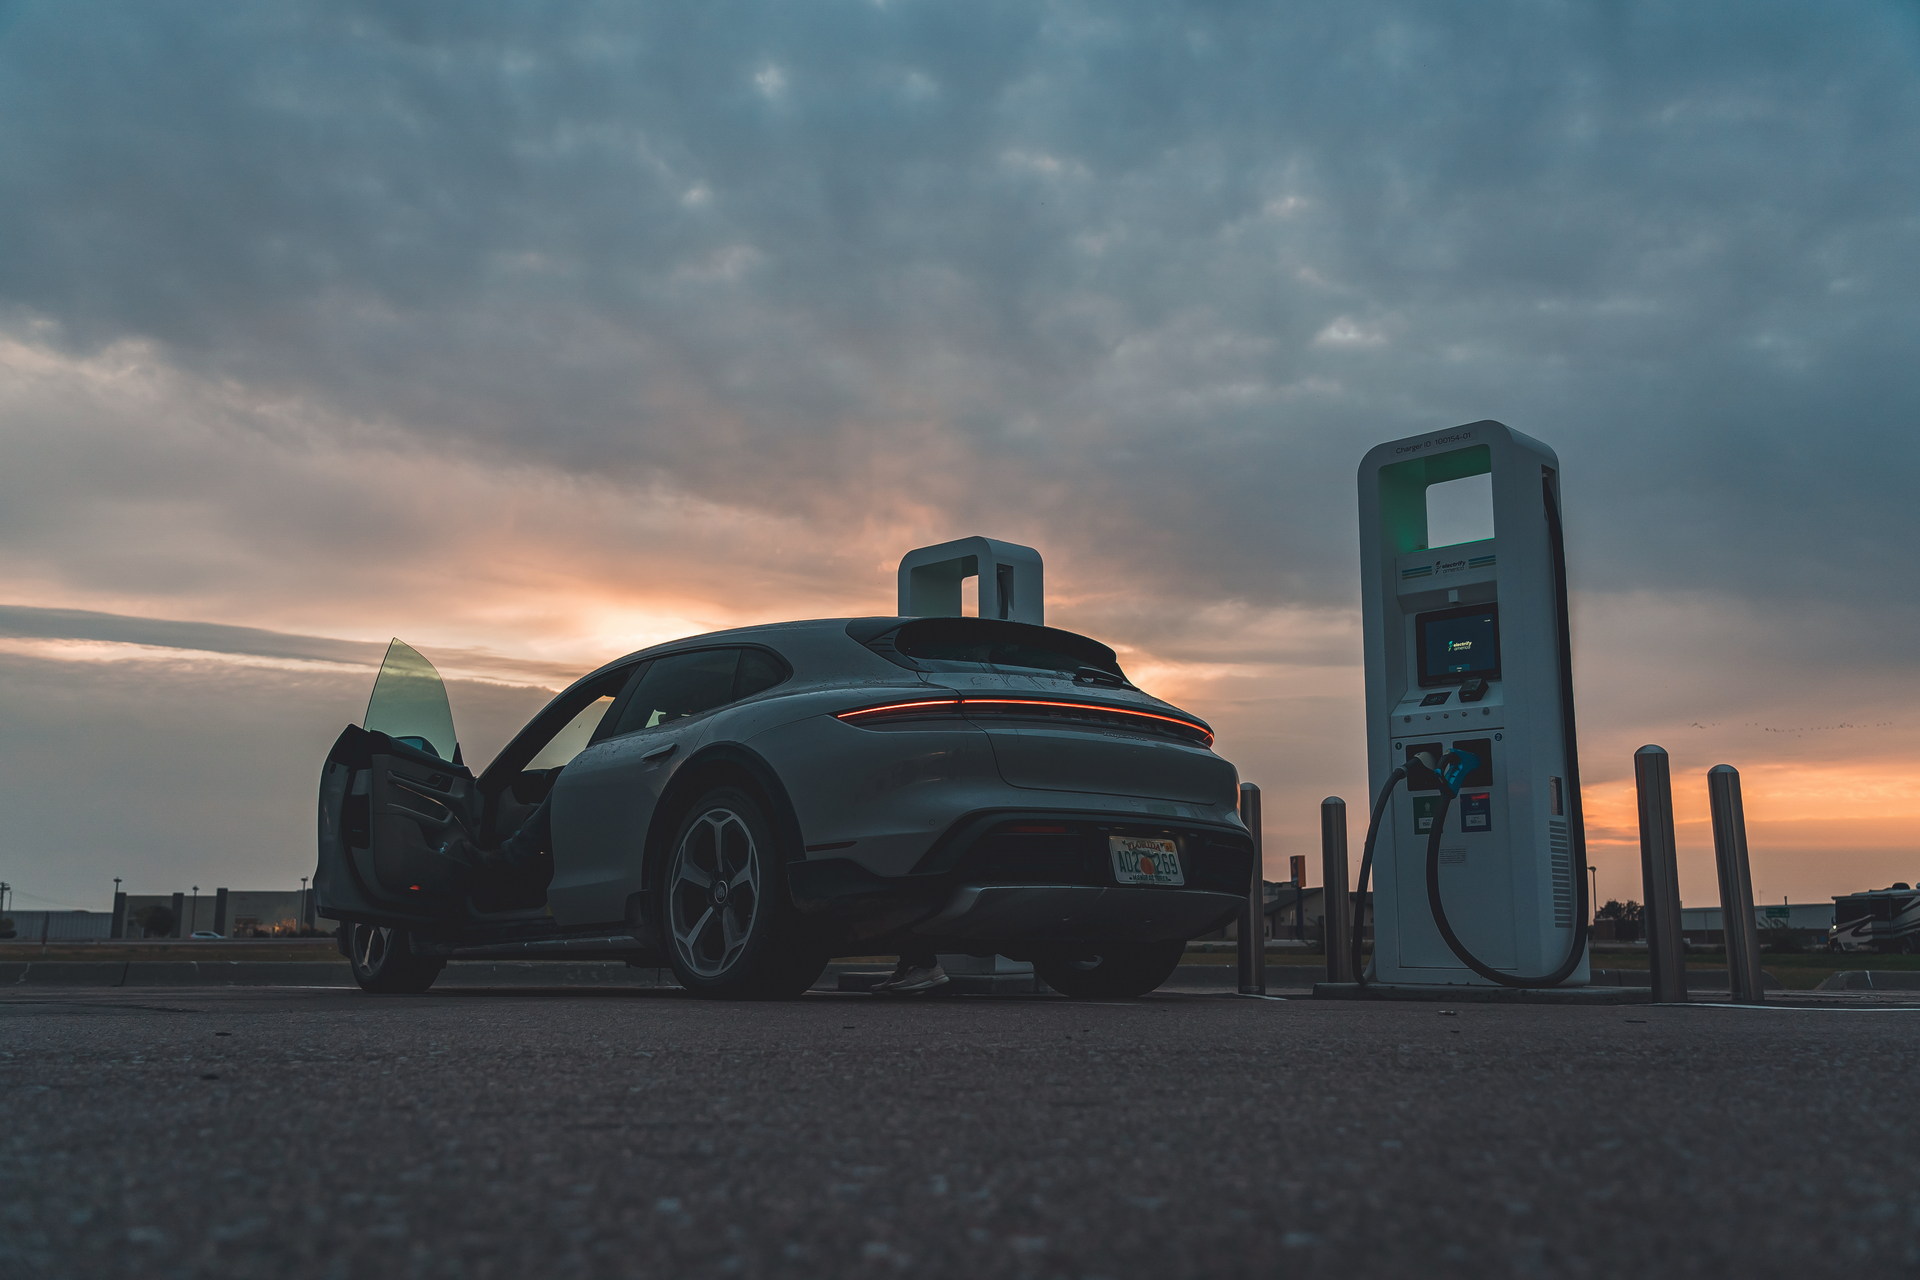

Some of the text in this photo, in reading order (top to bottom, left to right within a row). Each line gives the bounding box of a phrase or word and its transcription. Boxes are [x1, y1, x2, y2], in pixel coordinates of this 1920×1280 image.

[1395, 432, 1471, 454] Charger ID 100154-01
[1442, 560, 1466, 569] electrify
[1127, 840, 1161, 851] FLORIDA
[1154, 853, 1178, 875] 269
